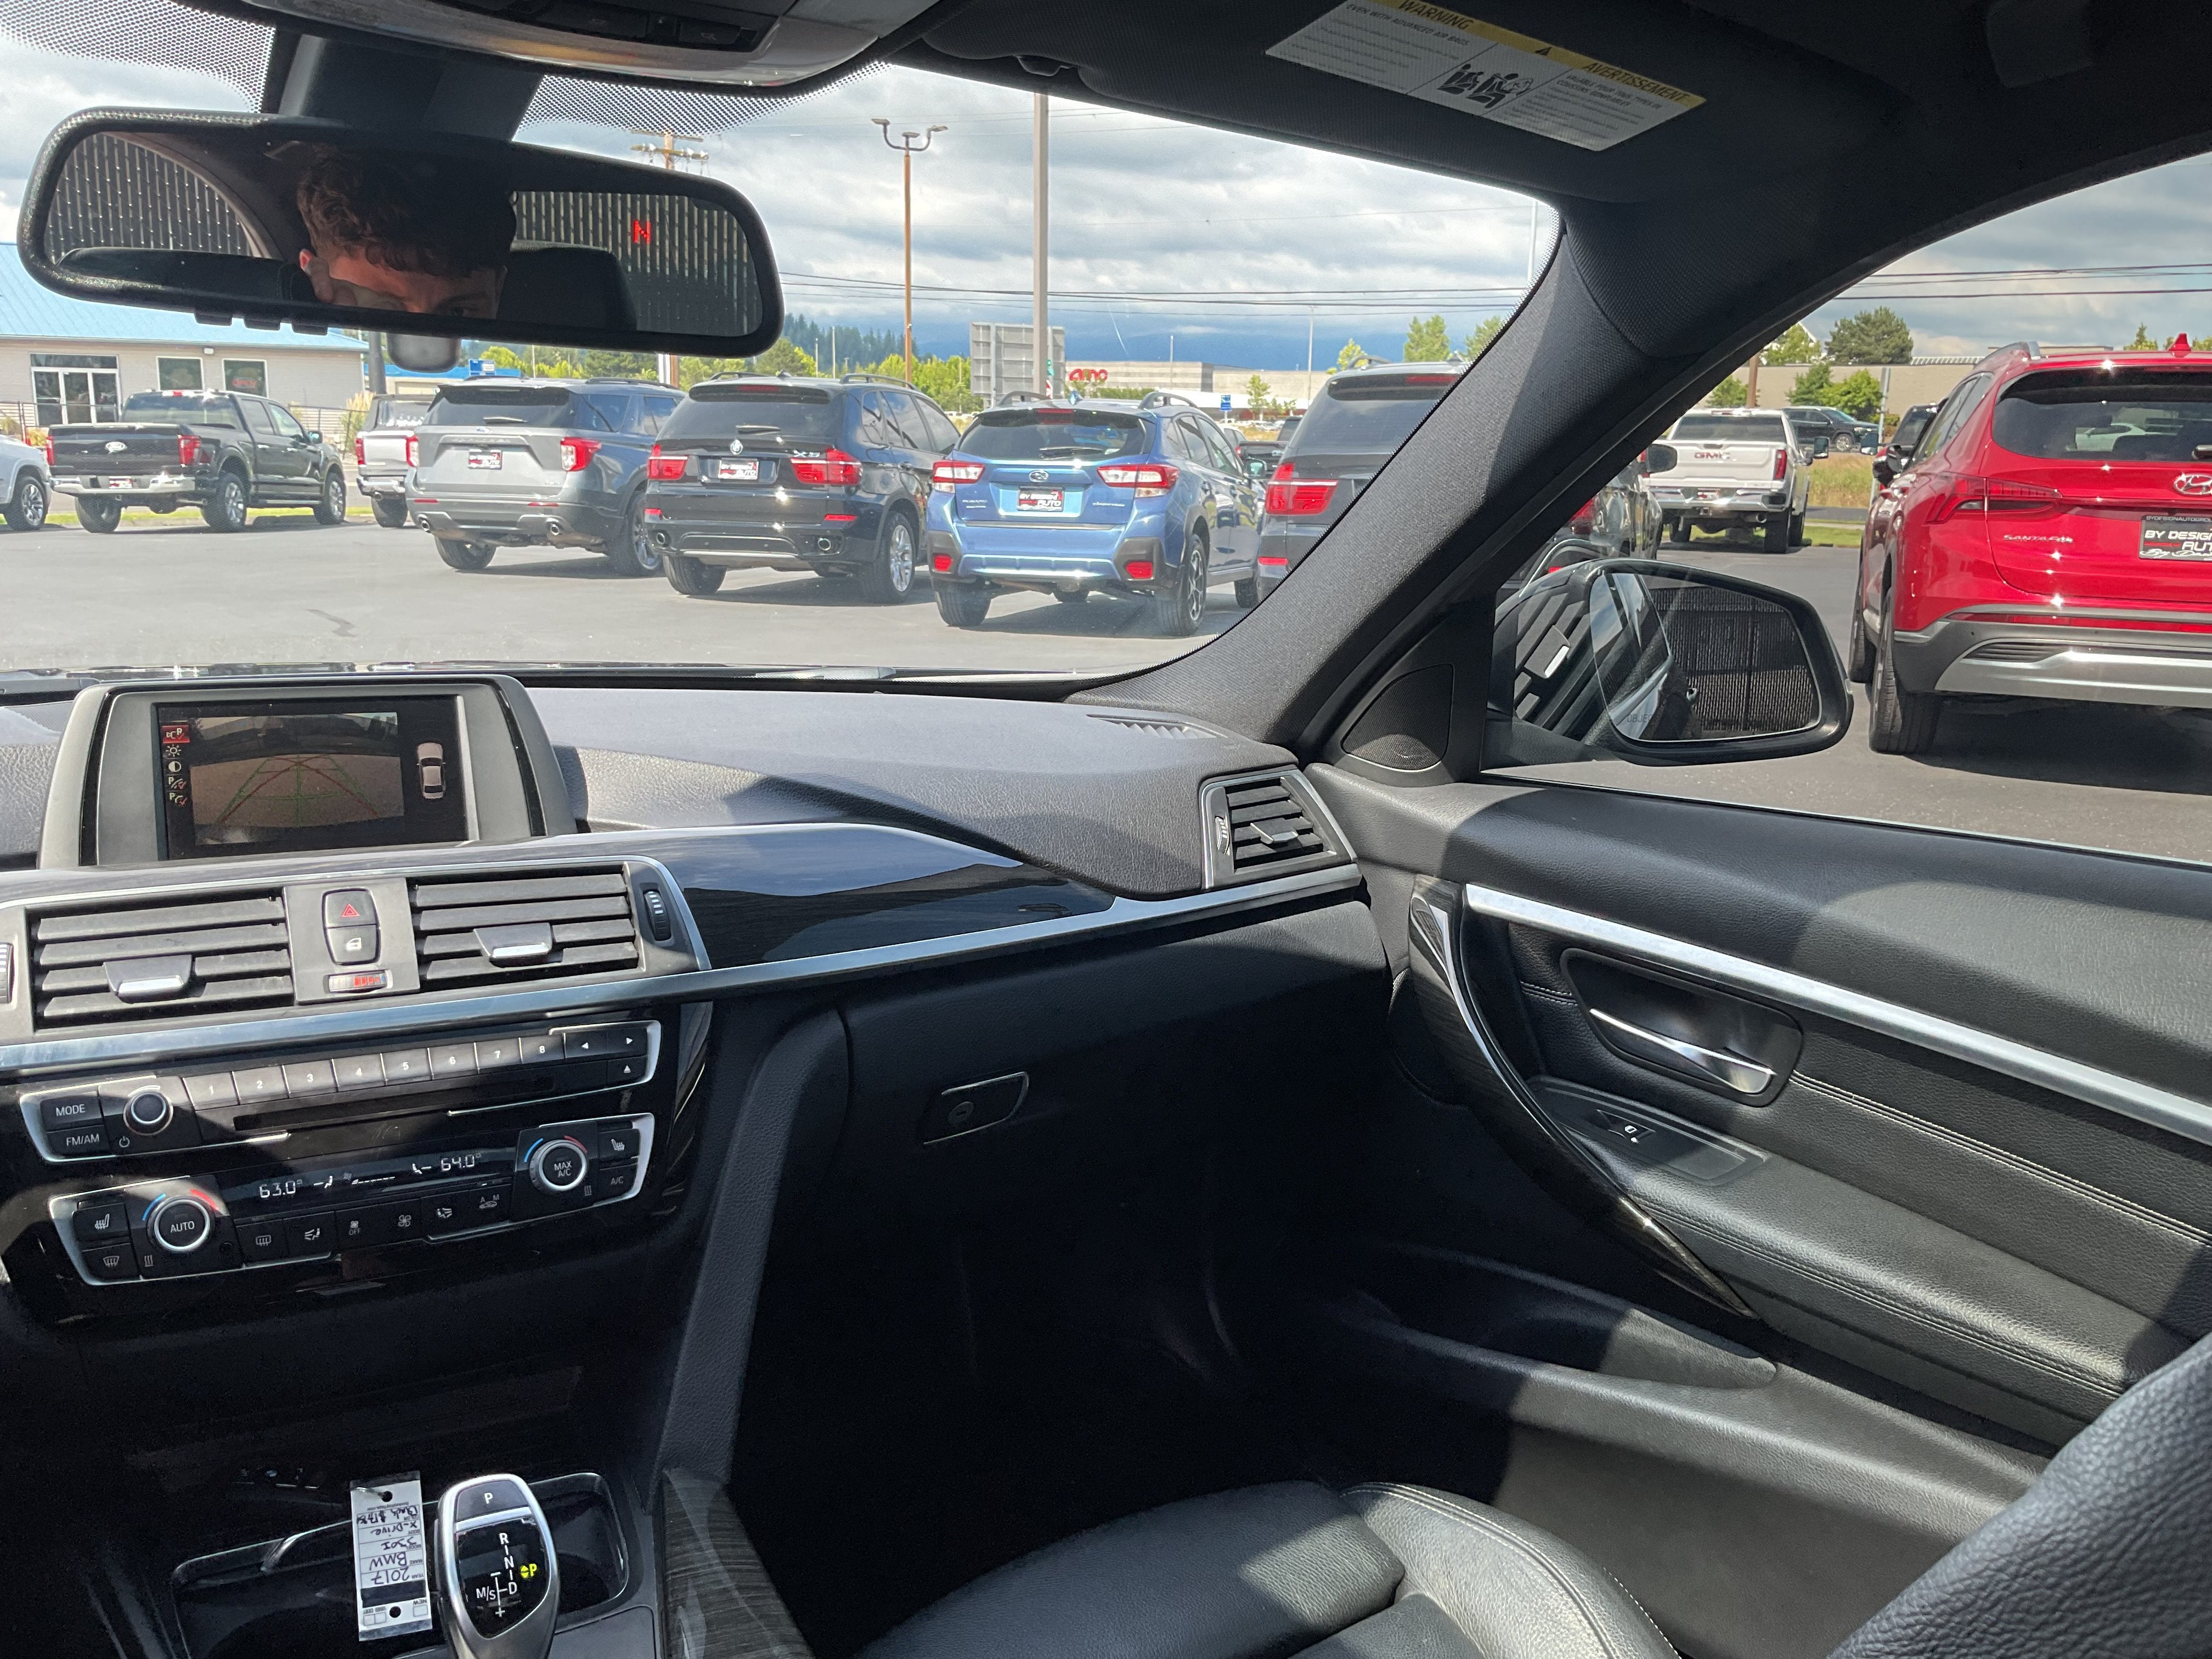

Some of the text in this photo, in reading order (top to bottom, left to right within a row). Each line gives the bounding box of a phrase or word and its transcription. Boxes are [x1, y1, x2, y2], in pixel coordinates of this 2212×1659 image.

[1399, 0, 1474, 30] WARNING
[1346, 4, 1369, 15] EVEN
[1369, 11, 1392, 21] WITH
[1392, 18, 1434, 34] ADVANCED
[1447, 36, 1471, 46] BAGS
[1581, 63, 1691, 101] AVERTISSEMENT
[634, 219, 650, 244] N
[2145, 530, 2165, 539] BY
[208, 1045, 545, 1094] 1 2 3 4 5 6 7 8
[55, 1104, 86, 1116] MODE
[66, 1133, 100, 1147] FM/AM
[554, 1160, 572, 1171] MAX
[558, 1169, 572, 1178] A/C
[610, 1176, 624, 1186] A/C
[170, 1221, 195, 1233] AUTO
[348, 1227, 361, 1235] OFF
[484, 1492, 493, 1504] P
[499, 1532, 509, 1545] R
[369, 1551, 407, 1571] BMW
[504, 1555, 514, 1569] N
[371, 1566, 410, 1584] 2017
[529, 1563, 537, 1576] P
[476, 1586, 496, 1601] M/S
[508, 1582, 517, 1595] D
